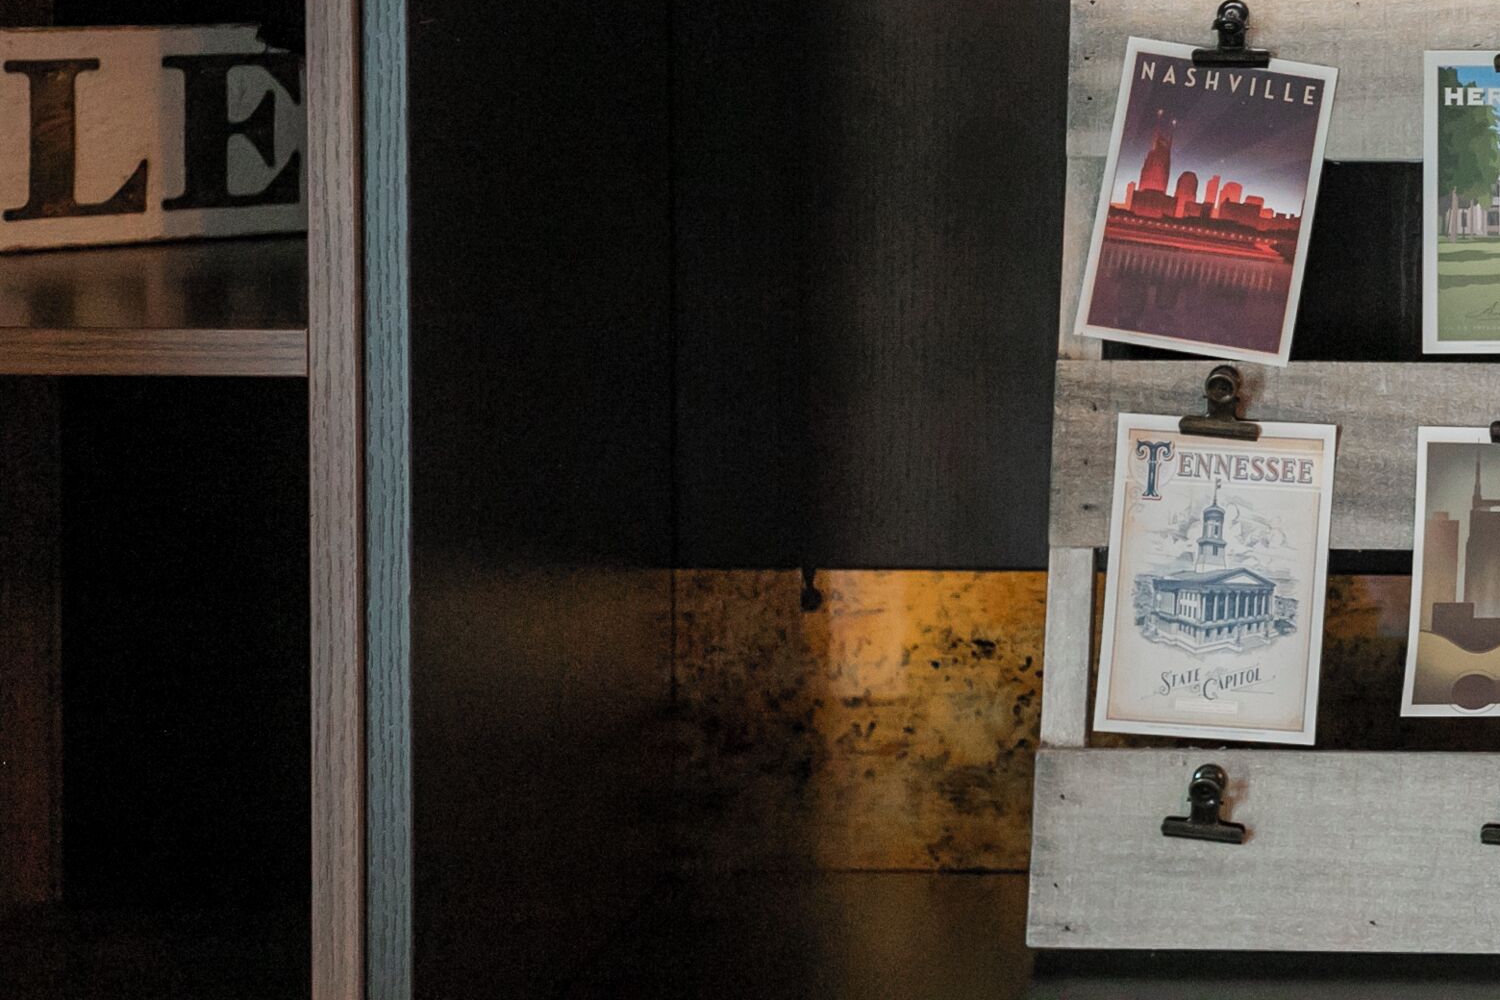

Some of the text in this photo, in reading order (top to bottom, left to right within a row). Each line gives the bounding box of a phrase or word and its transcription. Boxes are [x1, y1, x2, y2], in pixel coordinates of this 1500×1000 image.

[1141, 61, 1316, 105] NASHVILLE
[3, 52, 301, 222] LE
[1135, 438, 1314, 500] TENNESSEE
